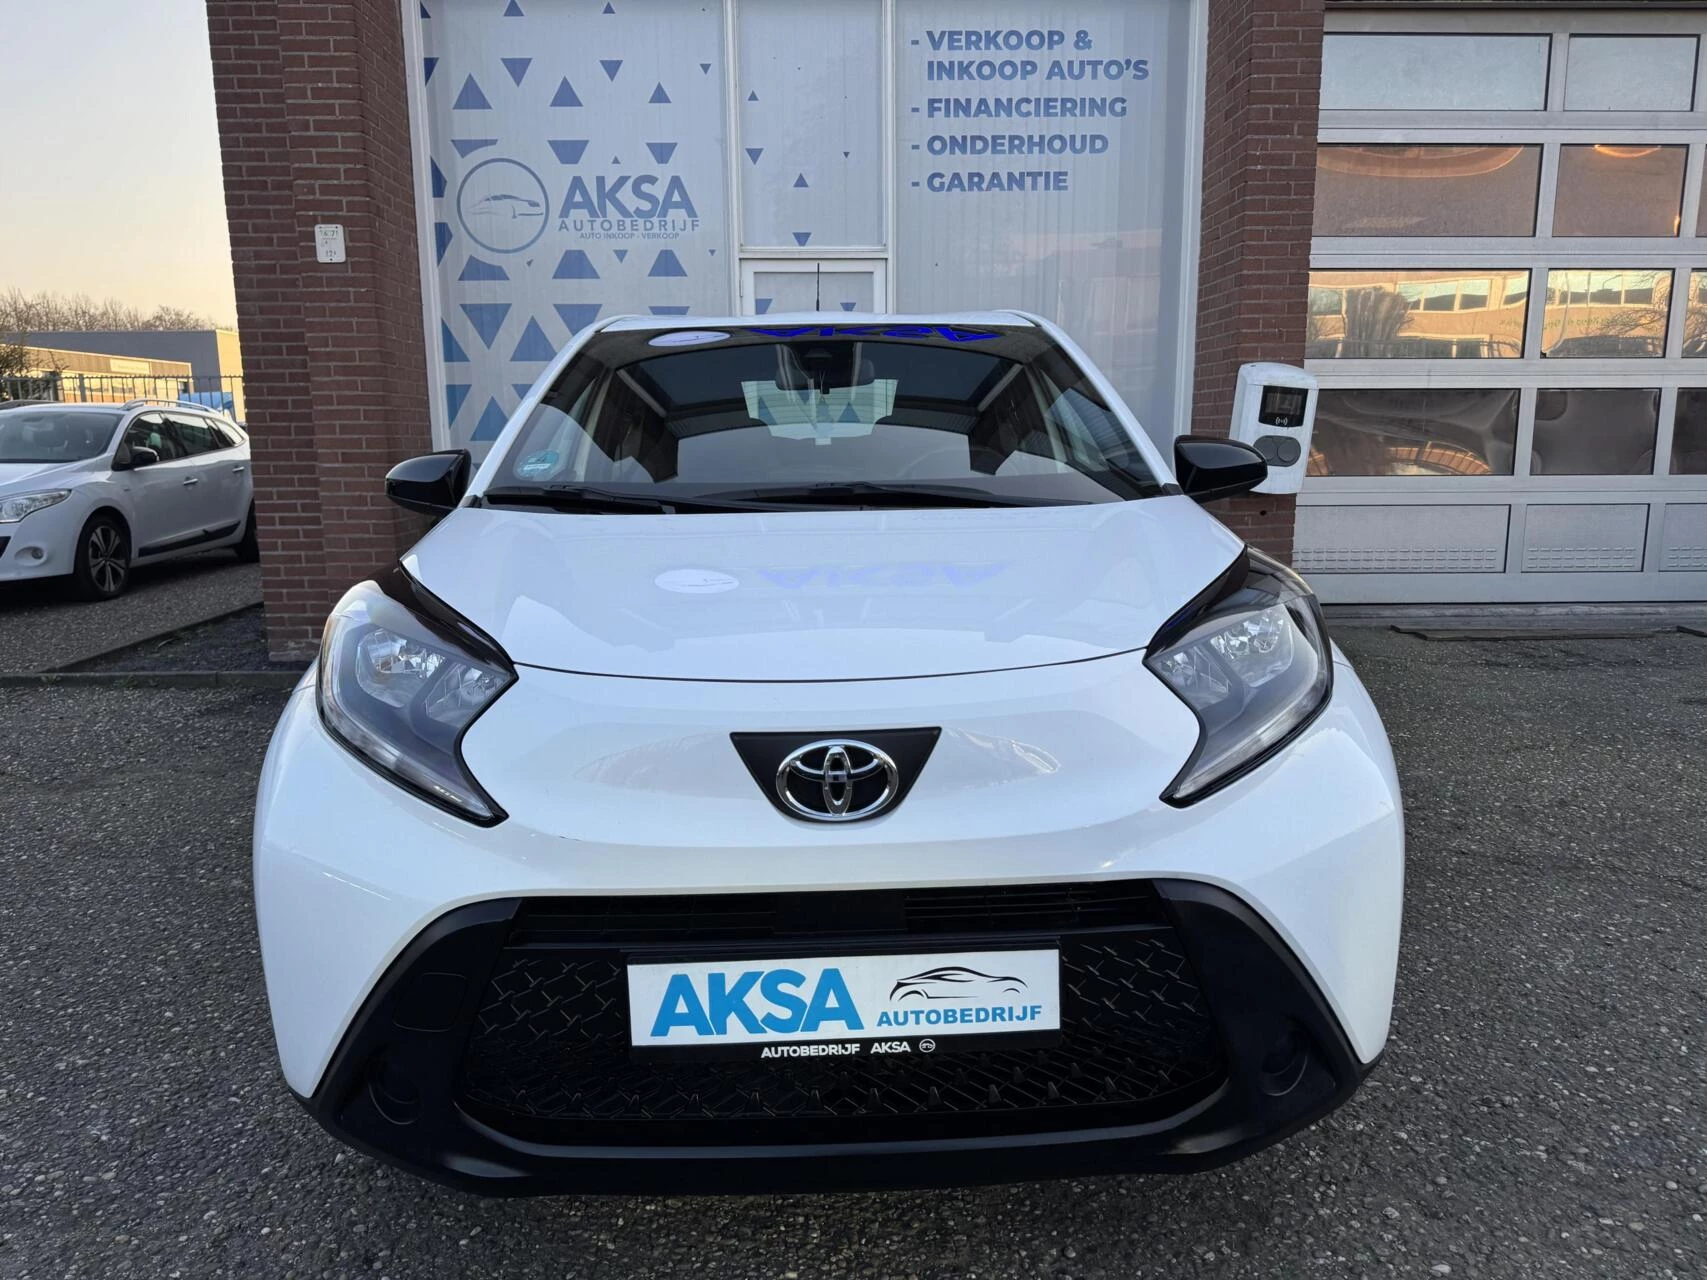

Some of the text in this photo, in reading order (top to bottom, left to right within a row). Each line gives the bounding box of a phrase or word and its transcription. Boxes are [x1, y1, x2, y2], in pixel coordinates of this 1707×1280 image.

[926, 29, 1065, 51] VERKOOP
[1072, 29, 1093, 51] &
[926, 58, 1150, 81] INKOOP AUTO'S
[927, 97, 1127, 118] FINANCIERING
[926, 134, 1109, 156] ONDERHOUD
[926, 171, 1069, 192] GARANTIE
[558, 174, 699, 219] AKSA
[558, 219, 700, 232] AUTOBEDRIJF
[579, 232, 602, 240] AUTO
[603, 232, 636, 240] INKOOP
[641, 232, 680, 240] VERKOOP
[650, 967, 864, 1038] AKSA
[876, 1004, 1042, 1027] AUTOBEDRIJF
[760, 1041, 911, 1059] AUTOBEDRIJF AKSA
